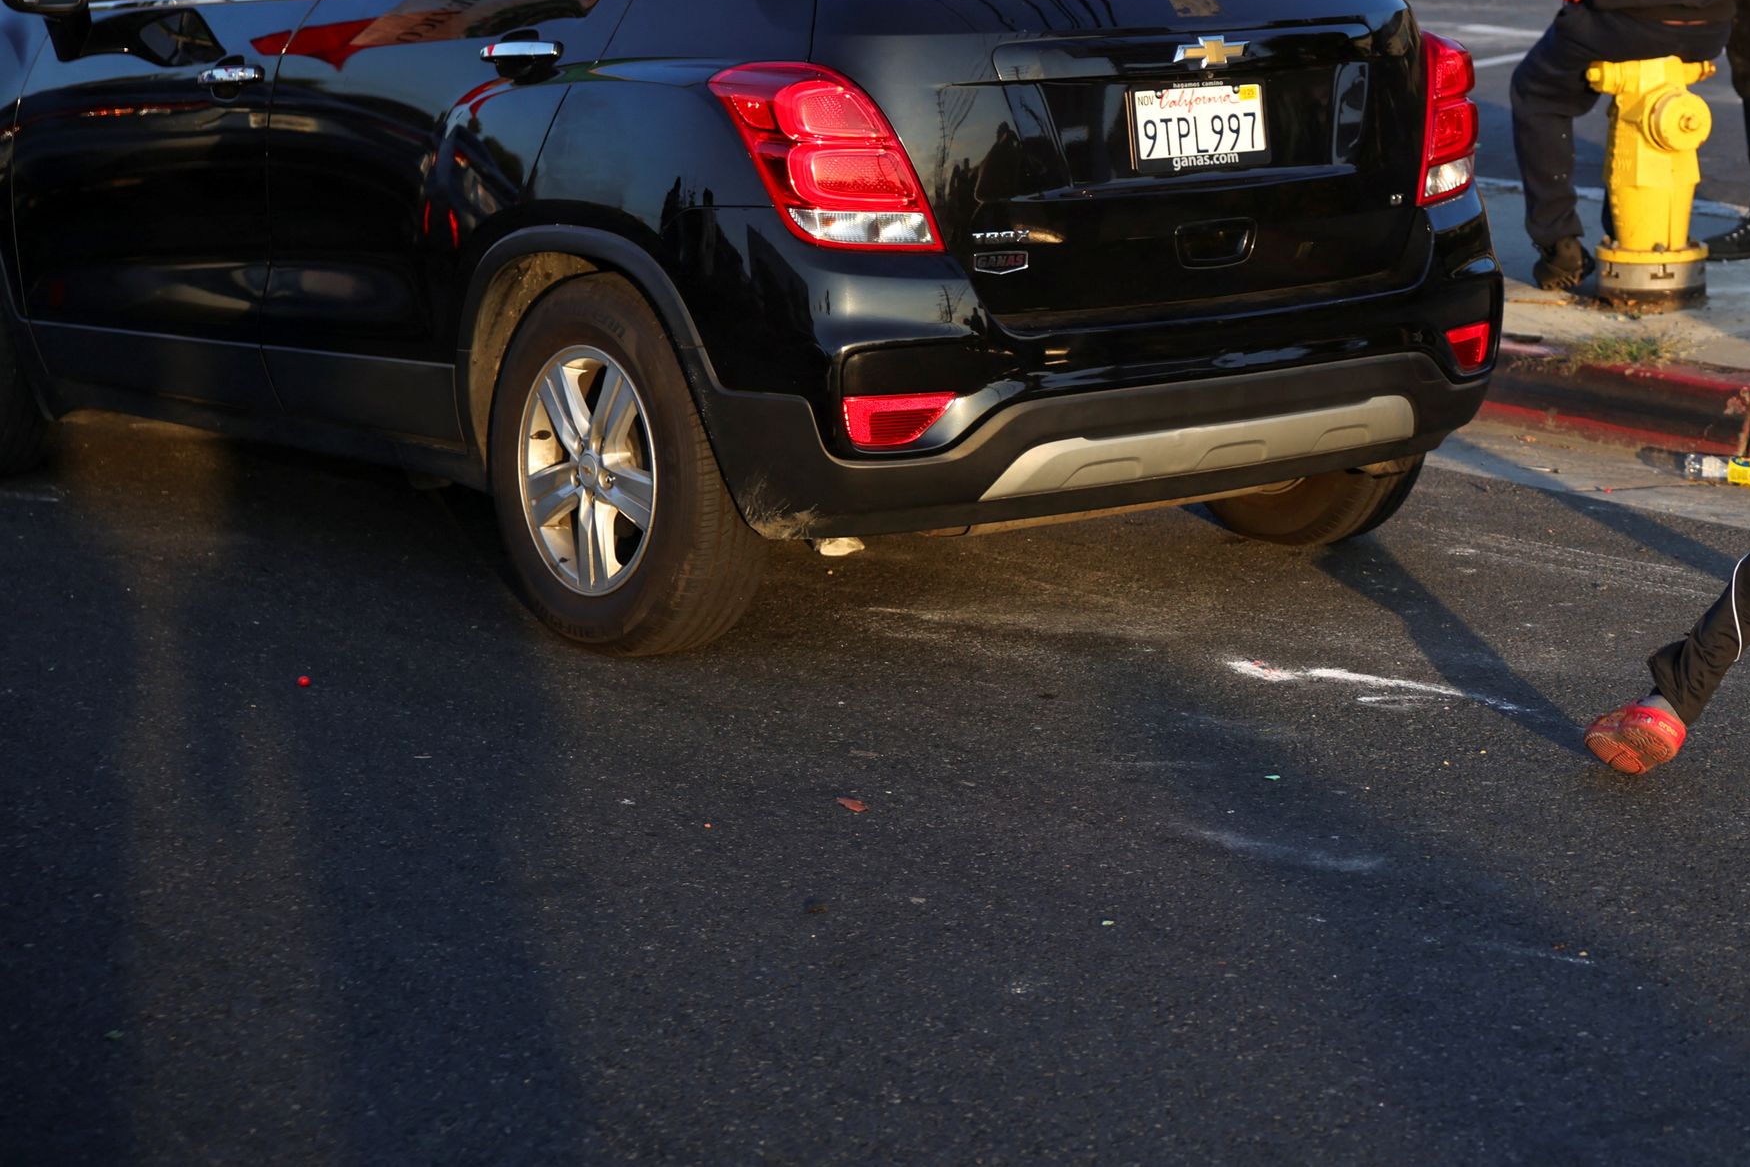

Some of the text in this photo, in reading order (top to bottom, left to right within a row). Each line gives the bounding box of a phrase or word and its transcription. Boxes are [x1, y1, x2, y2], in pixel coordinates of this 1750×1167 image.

[1137, 95, 1155, 106] NOV
[1159, 89, 1241, 113] California
[1143, 112, 1256, 158] 9TPL997
[1172, 153, 1240, 172] ganas.com
[977, 254, 1025, 269] GANAS
